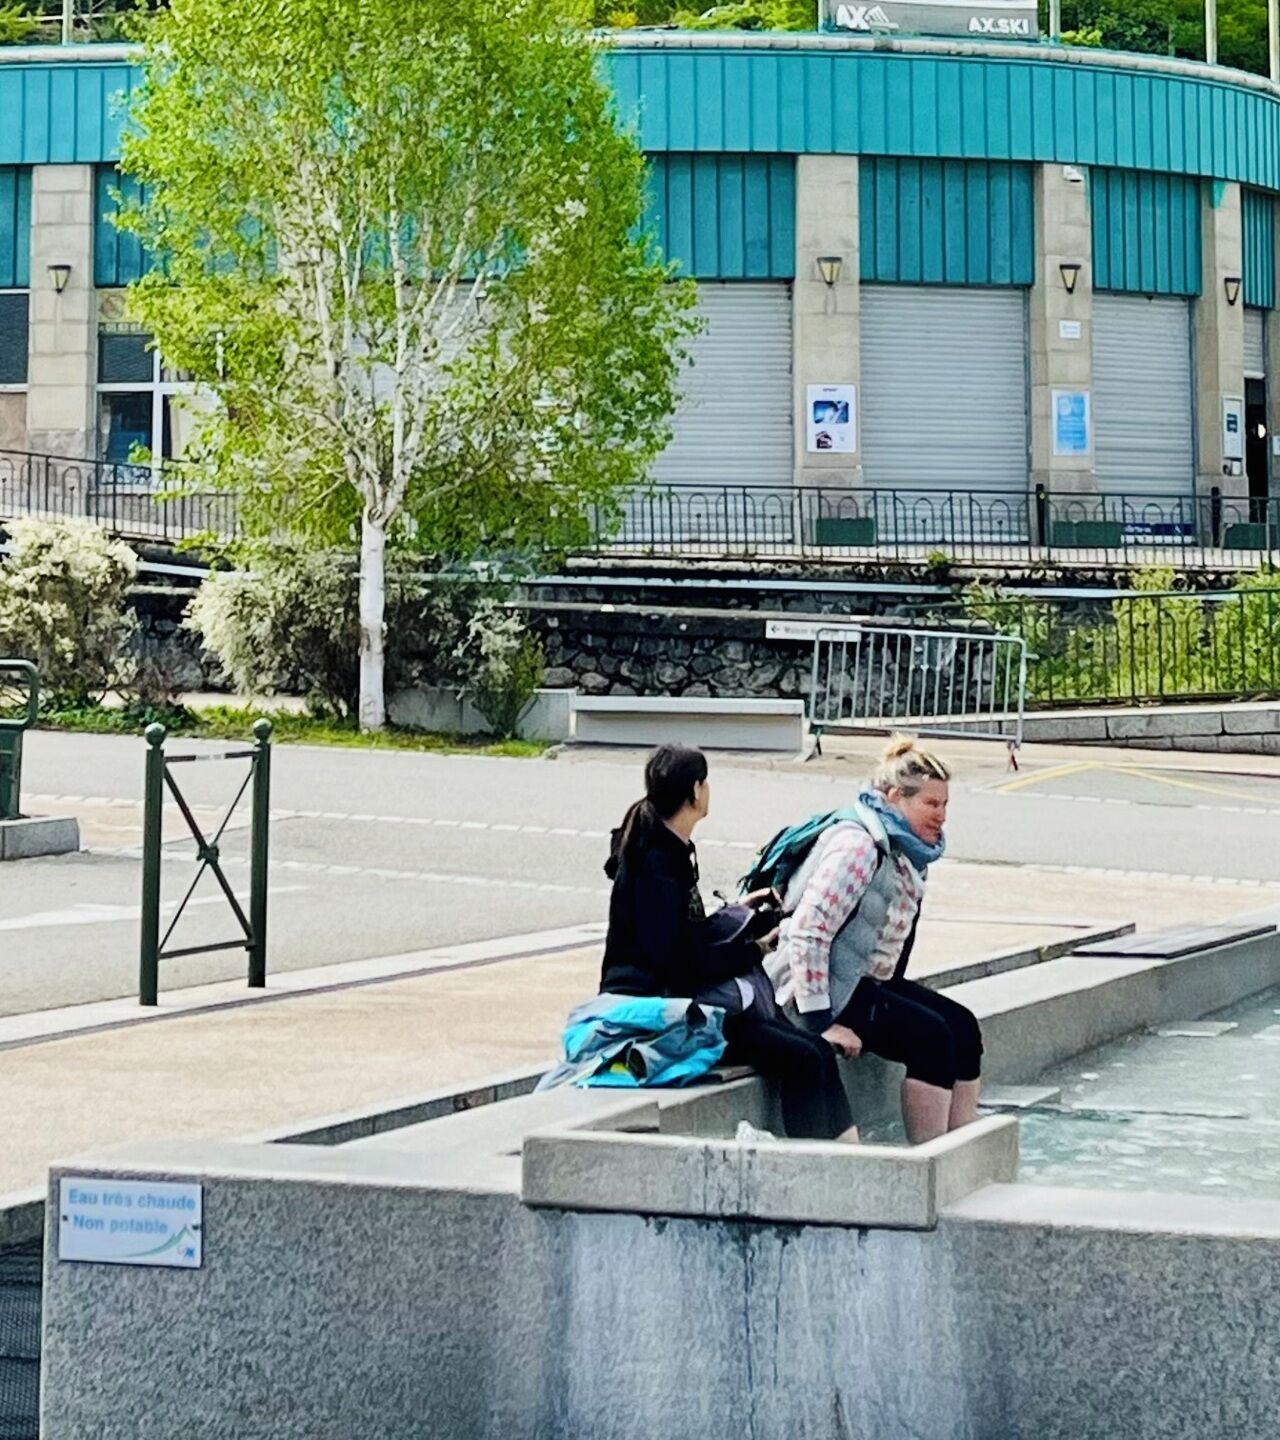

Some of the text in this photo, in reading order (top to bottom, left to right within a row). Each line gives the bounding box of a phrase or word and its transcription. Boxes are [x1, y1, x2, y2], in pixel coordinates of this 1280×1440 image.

[836, 4, 871, 30] AX
[968, 16, 1030, 35] AX.SKI
[69, 1188, 196, 1210] Eau très chaude
[73, 1214, 168, 1234] Non potable
